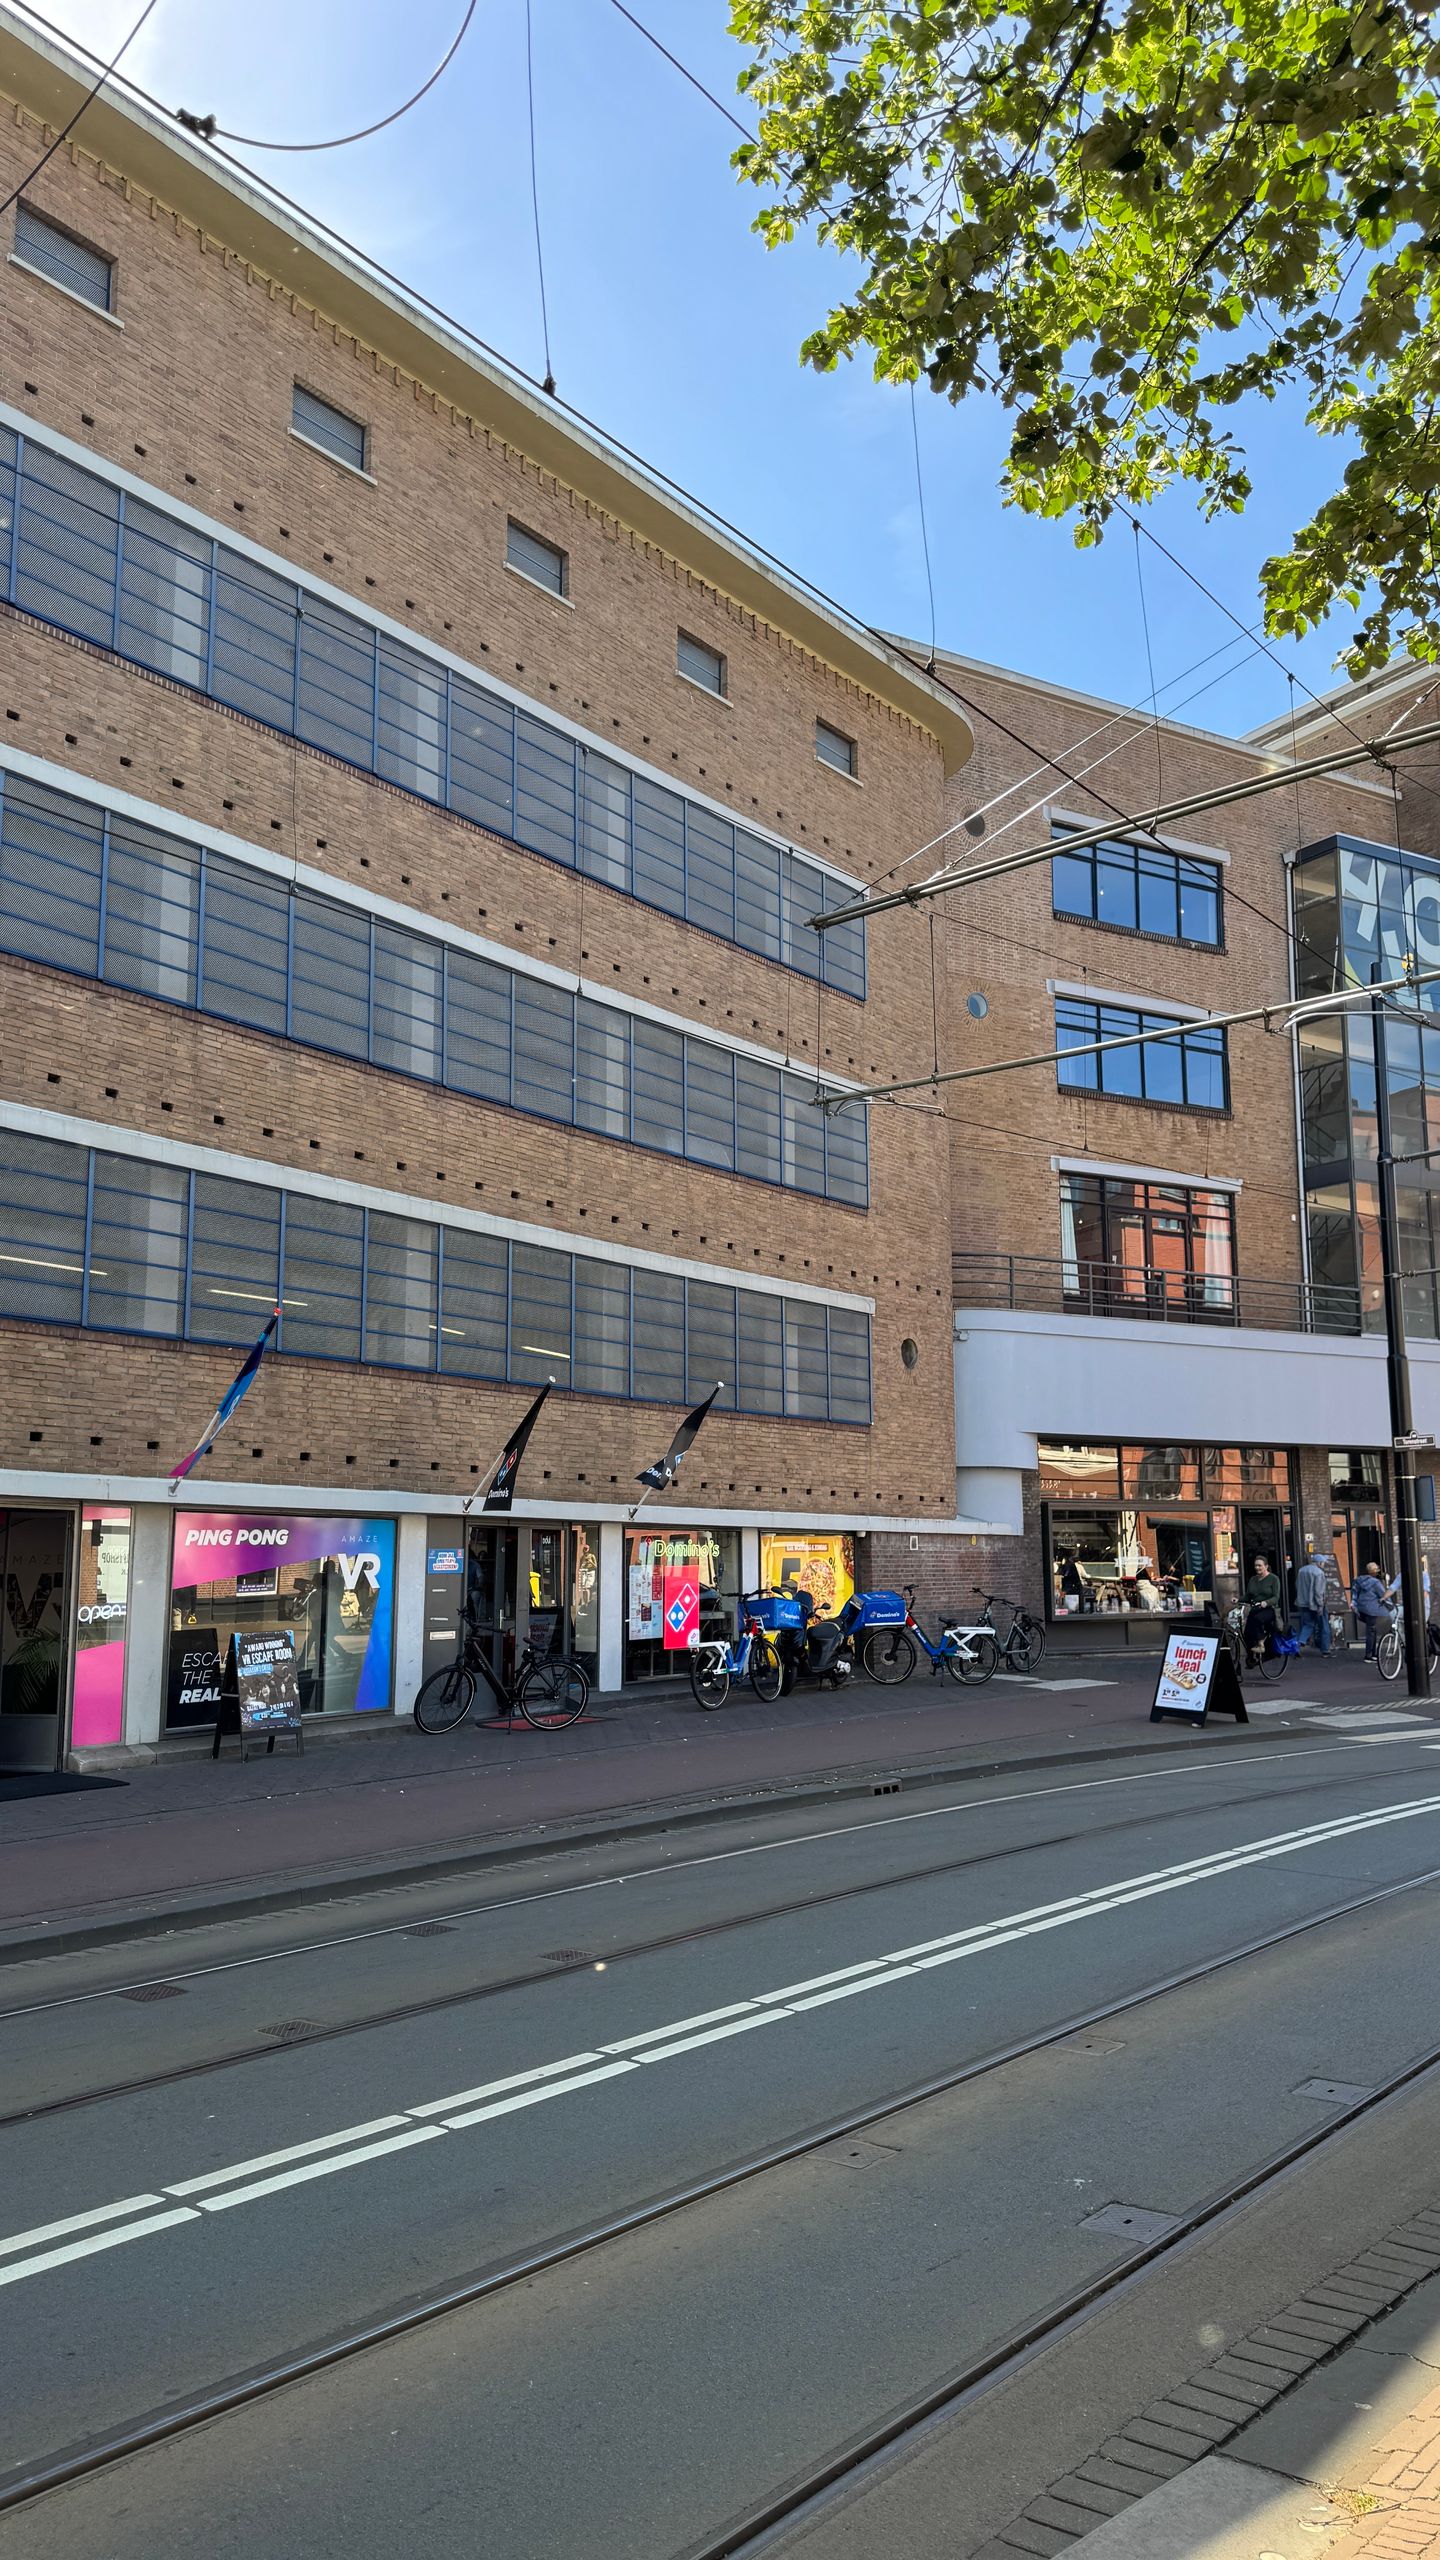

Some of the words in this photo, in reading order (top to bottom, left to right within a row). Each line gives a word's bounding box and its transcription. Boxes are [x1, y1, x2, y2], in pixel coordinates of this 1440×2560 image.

[185, 1529, 232, 1546] PING
[235, 1529, 289, 1546] PONG
[341, 1535, 379, 1543] AMAZE
[655, 1539, 720, 1557] Domino's
[337, 1553, 381, 1590] VR
[252, 1651, 274, 1664] ESCAPE
[1175, 1646, 1207, 1661] lunch
[1177, 1659, 1201, 1672] deal
[183, 1669, 213, 1686] THE
[179, 1687, 221, 1704] REAL
